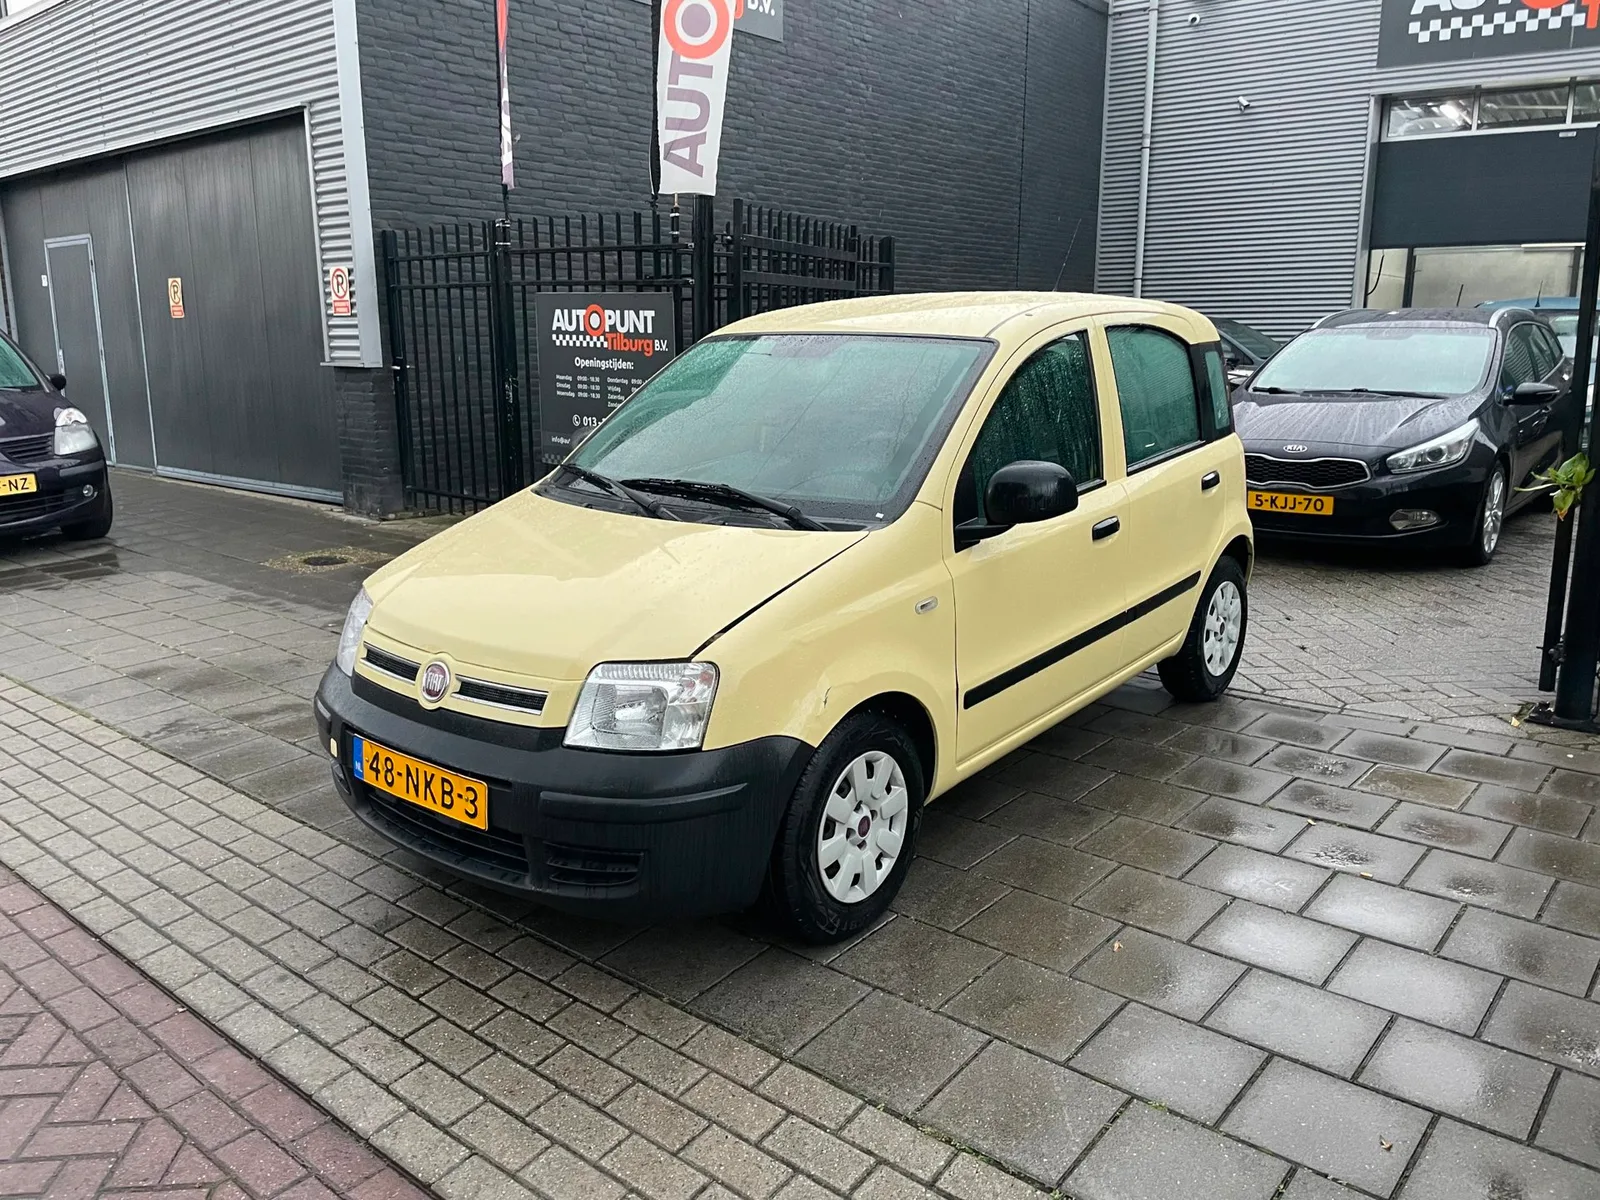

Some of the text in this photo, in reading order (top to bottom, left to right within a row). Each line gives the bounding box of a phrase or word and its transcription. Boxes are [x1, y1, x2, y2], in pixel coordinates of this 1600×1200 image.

[552, 304, 655, 336] AUTOPUNT
[605, 333, 668, 357] Tilburg B.V.
[574, 357, 634, 371] Openingstijden:
[1286, 444, 1303, 452] KIA
[0, 477, 29, 491] -NZ
[1255, 494, 1324, 512] 5-KJJ-70
[426, 672, 444, 692] FIAT
[369, 751, 478, 819] 48-NKB-3
